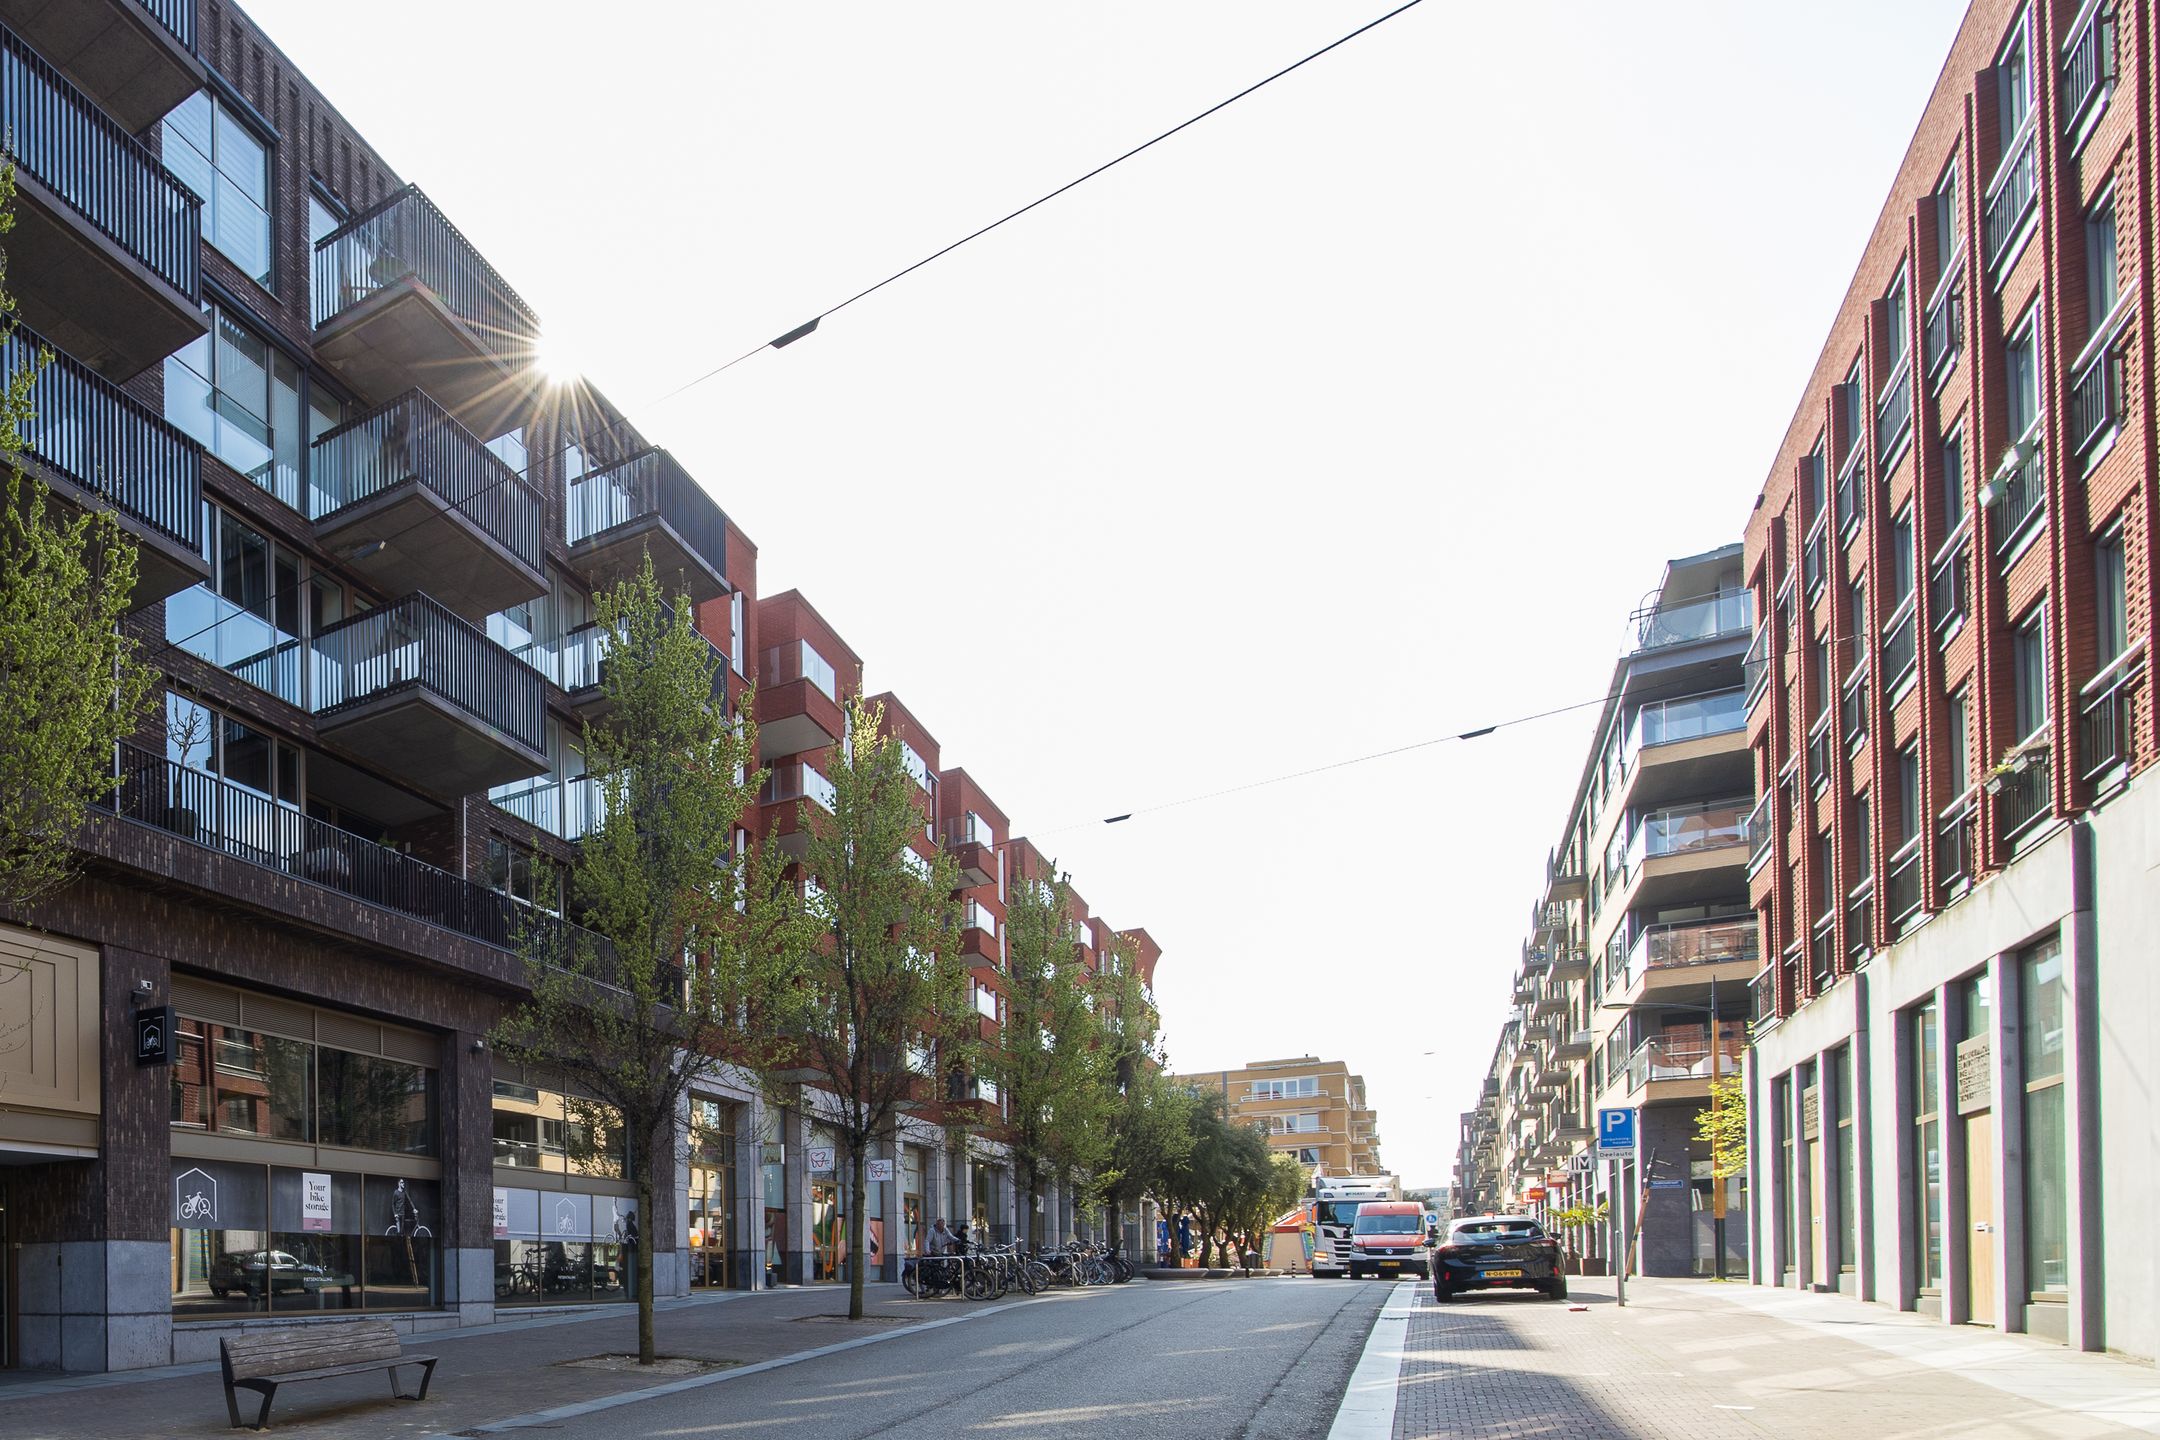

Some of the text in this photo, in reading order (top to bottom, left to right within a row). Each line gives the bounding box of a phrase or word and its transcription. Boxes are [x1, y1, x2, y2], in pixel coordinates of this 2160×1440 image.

[1606, 1111, 1626, 1133] P
[309, 1181, 326, 1191] Your
[309, 1192, 325, 1202] bike
[305, 1202, 329, 1211] storage
